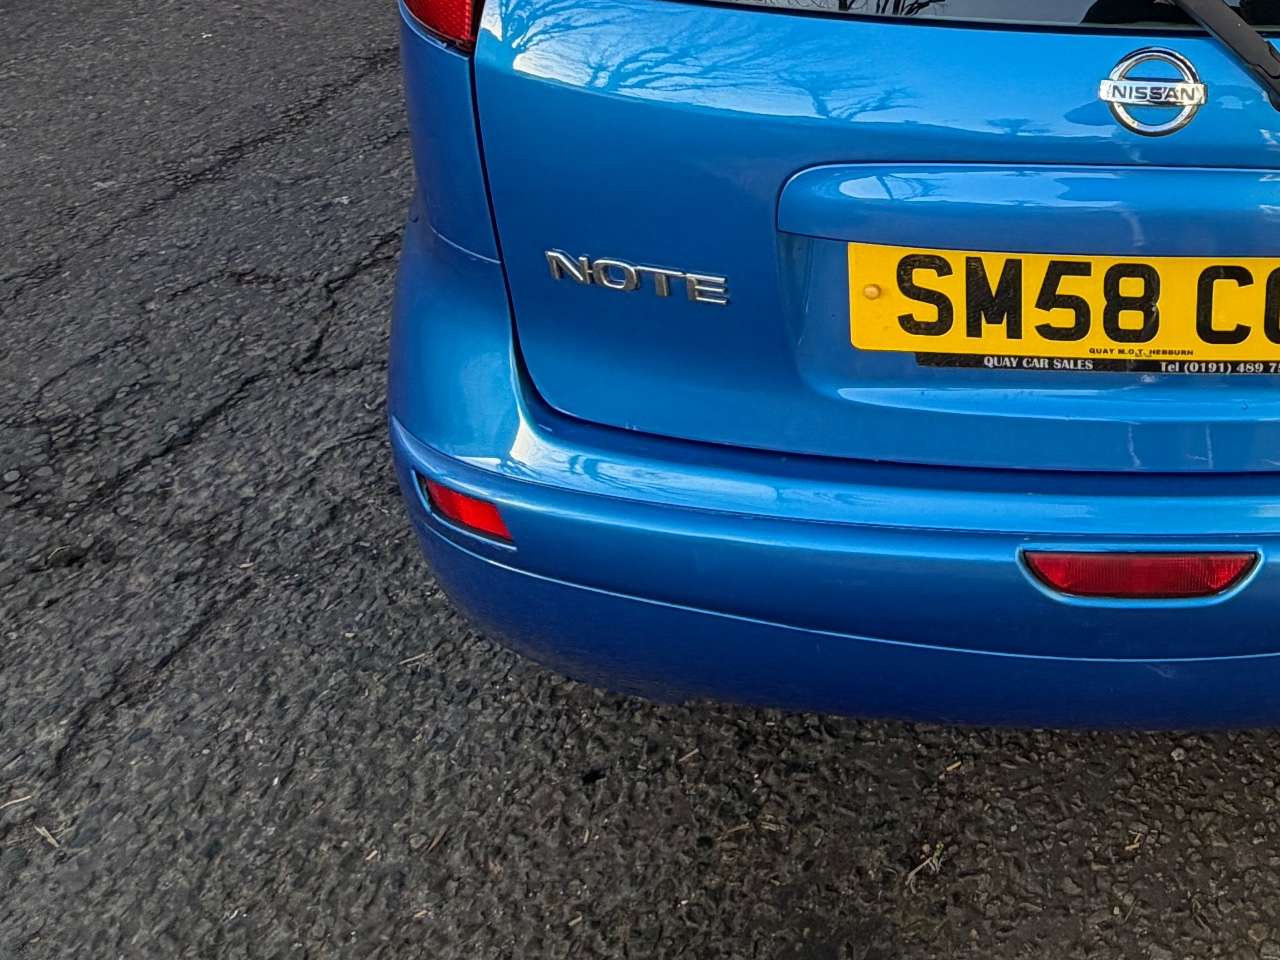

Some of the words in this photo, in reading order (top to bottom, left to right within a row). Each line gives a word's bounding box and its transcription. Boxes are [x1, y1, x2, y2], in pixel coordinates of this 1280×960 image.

[1111, 84, 1195, 101] NISSAN
[544, 247, 730, 306] NOTE
[896, 253, 1161, 342] SM58
[1088, 347, 1115, 355] QUAY
[983, 356, 1019, 370] QUAY
[1022, 357, 1049, 369] CAR
[1053, 358, 1093, 370] SALES
[1160, 361, 1180, 372] Tel
[1183, 361, 1231, 374] (0191)
[1236, 362, 1264, 373] 489
